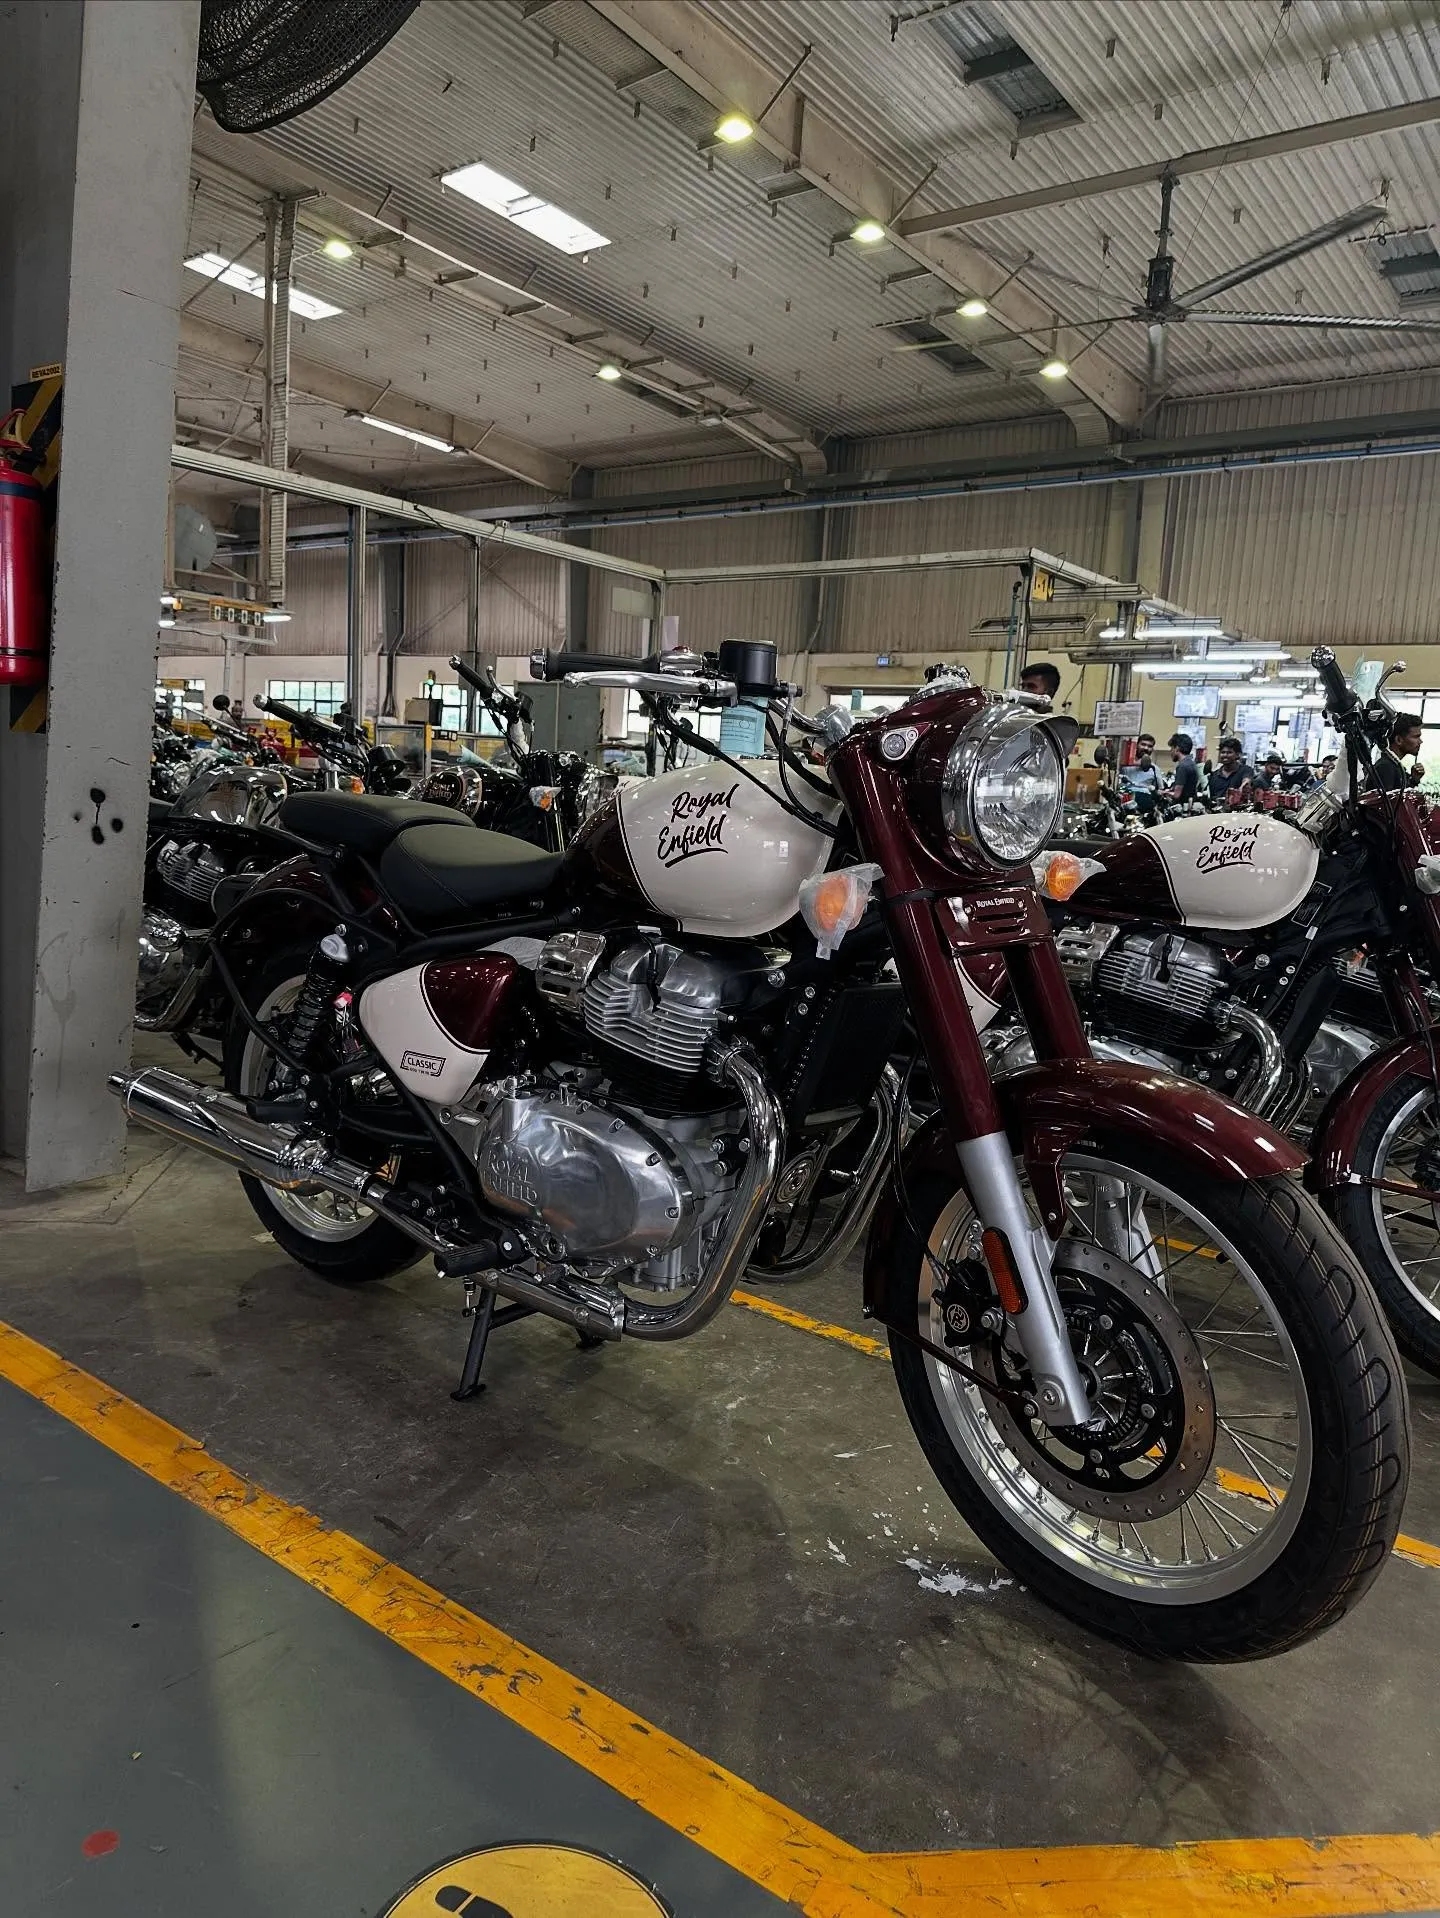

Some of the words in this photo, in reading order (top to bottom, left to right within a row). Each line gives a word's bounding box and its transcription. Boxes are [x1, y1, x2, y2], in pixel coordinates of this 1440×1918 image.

[671, 783, 740, 823] Royal
[657, 814, 727, 860] Enfield
[1209, 824, 1260, 844] Royal
[1196, 841, 1256, 868] Enfield
[407, 1057, 437, 1071] CLASSIC
[488, 1150, 533, 1185] ROYAL
